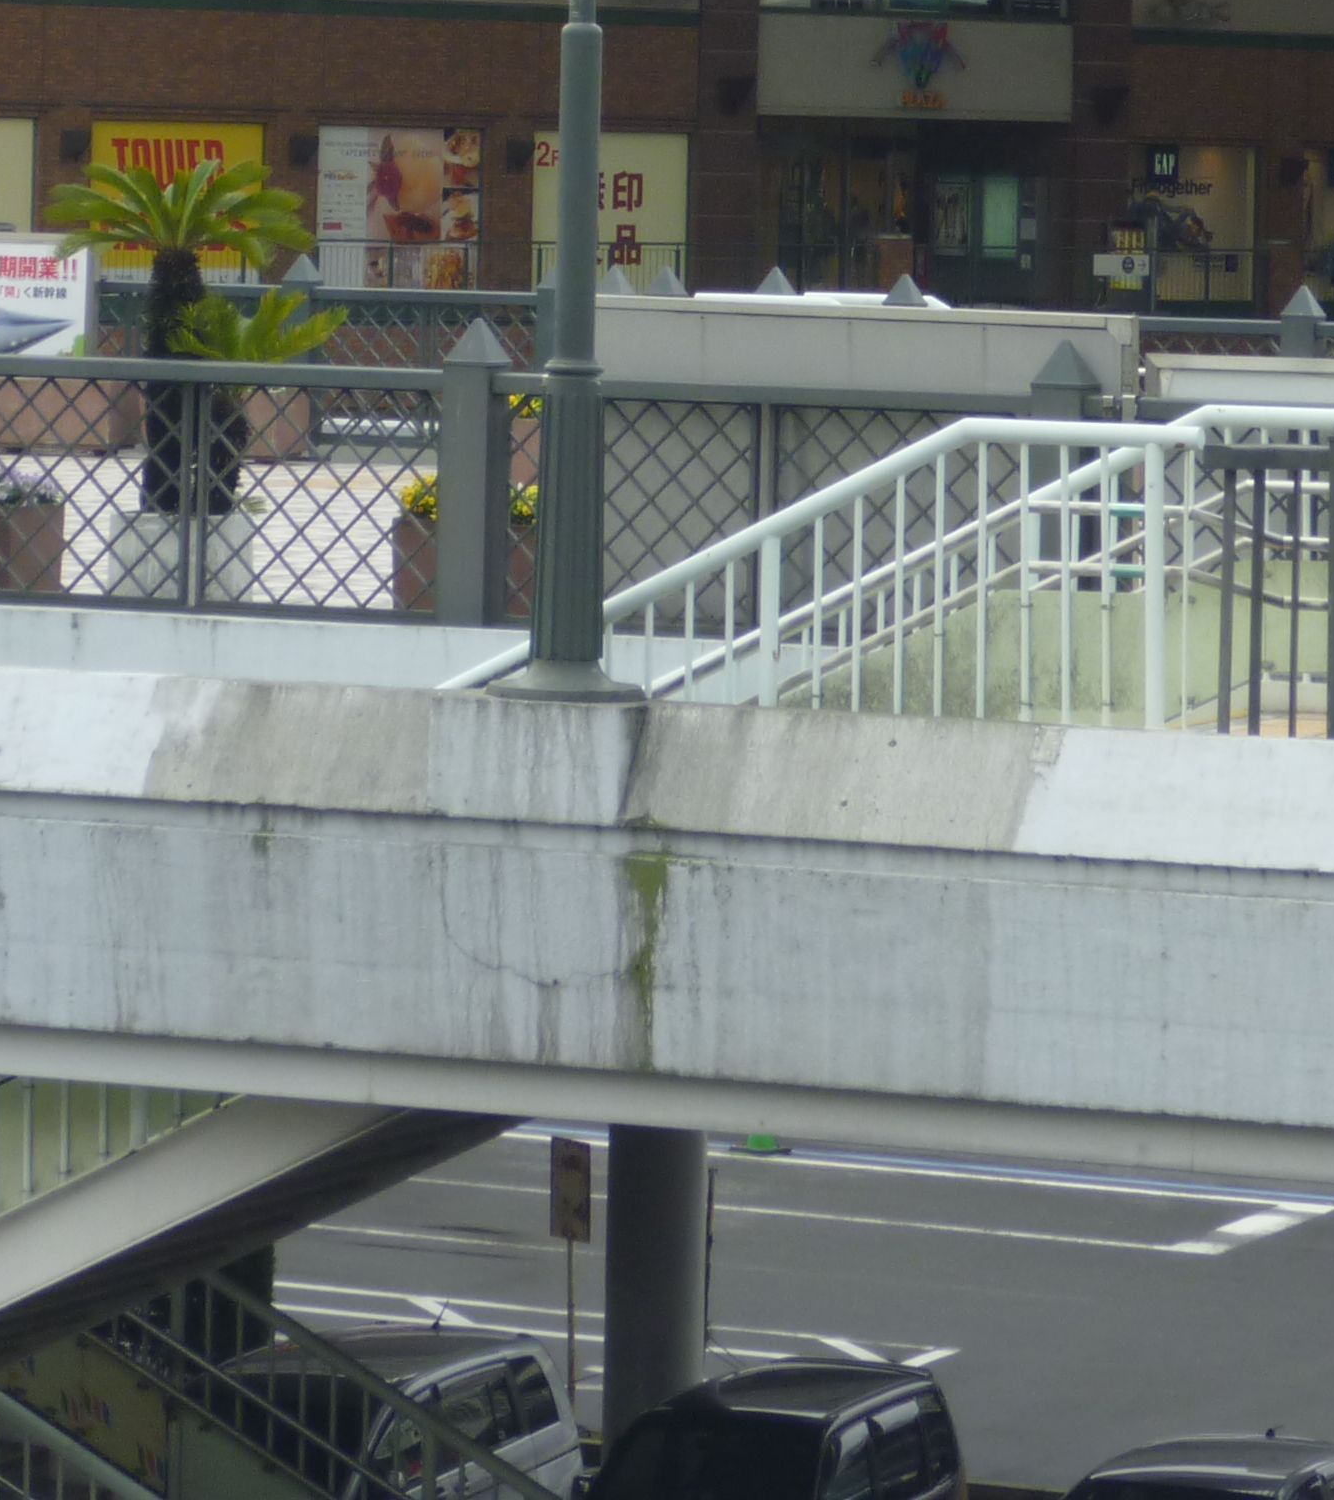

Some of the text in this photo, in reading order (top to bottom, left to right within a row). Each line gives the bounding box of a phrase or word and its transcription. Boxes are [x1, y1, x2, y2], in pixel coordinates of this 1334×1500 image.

[536, 141, 560, 167] 2F
[1154, 153, 1175, 176] GAP
[598, 171, 644, 212] 印
